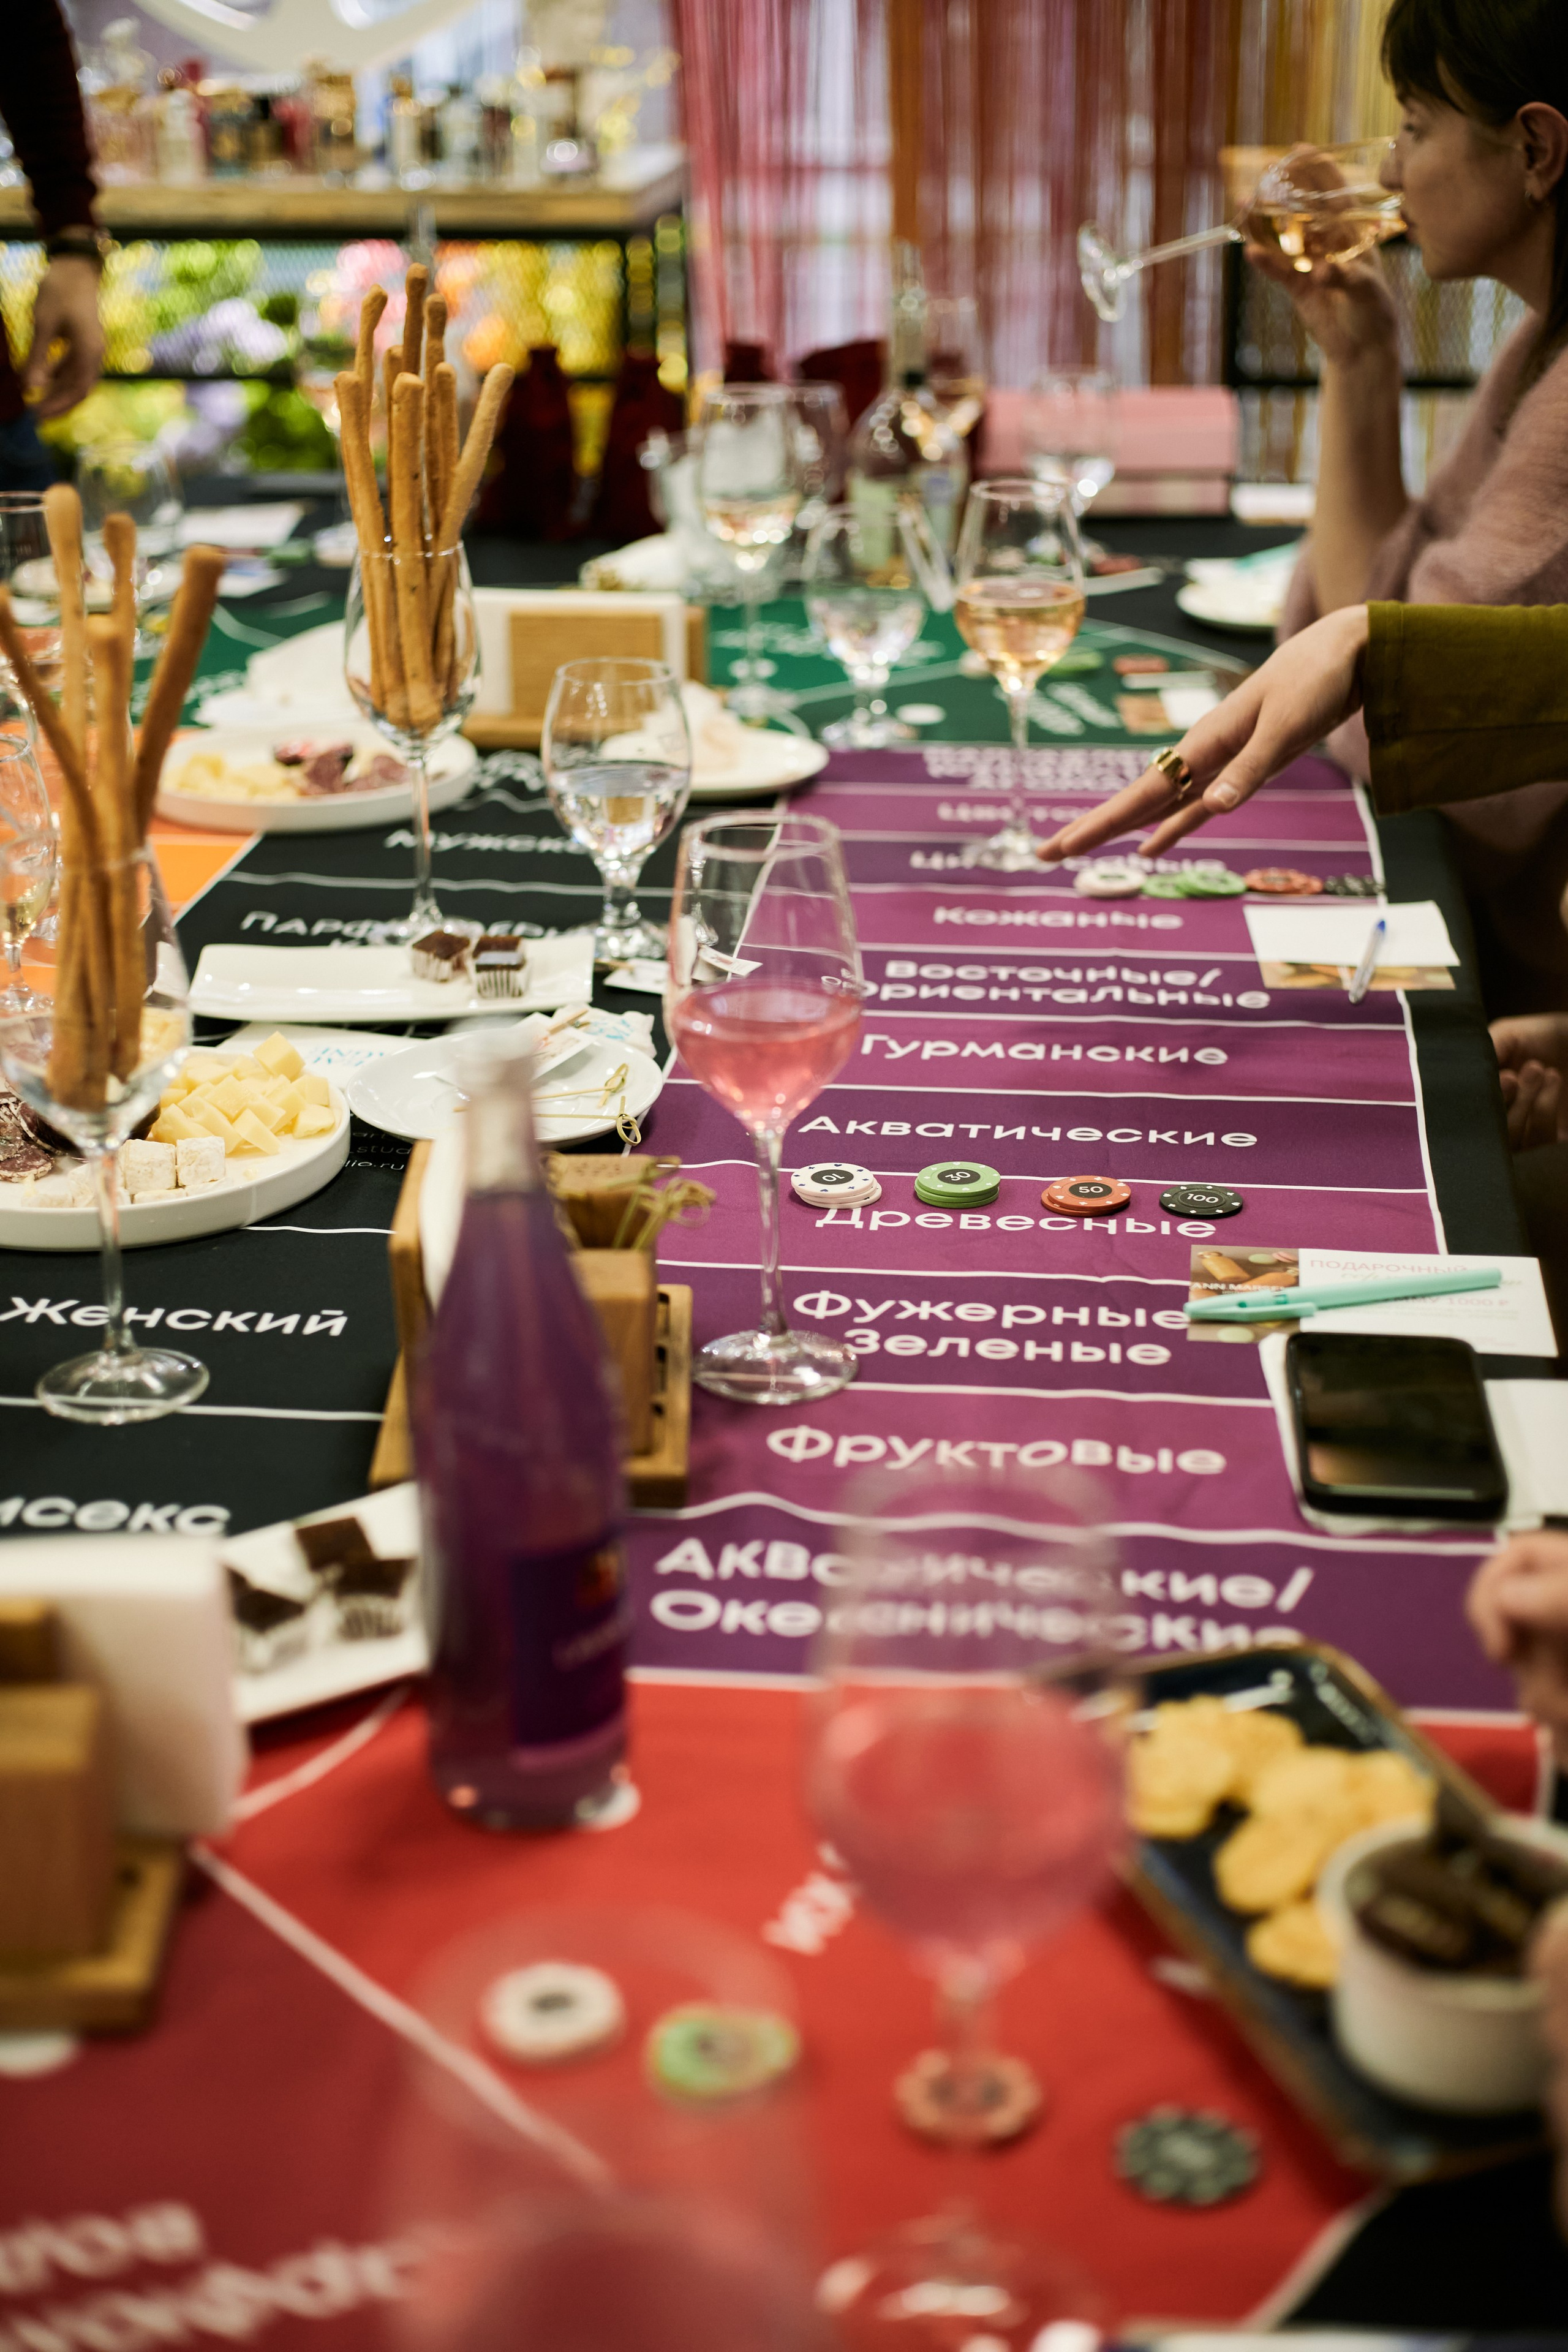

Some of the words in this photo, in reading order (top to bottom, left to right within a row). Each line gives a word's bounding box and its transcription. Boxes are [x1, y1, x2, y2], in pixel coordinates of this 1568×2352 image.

[933, 905, 1185, 930] Кожаные
[884, 959, 1223, 988] Восточные/
[861, 1033, 1229, 1065] Гурманские
[797, 1115, 1258, 1147] Акватические
[821, 1172, 845, 1182] 10
[944, 1171, 971, 1182] 30
[1186, 1193, 1219, 1204] 100
[815, 1207, 1216, 1238] Древесные
[0, 1296, 348, 1336] Женский
[793, 1290, 1191, 1330] Фужерные
[843, 1328, 1172, 1365] Зеленые
[766, 1425, 1227, 1475] Фруктовые
